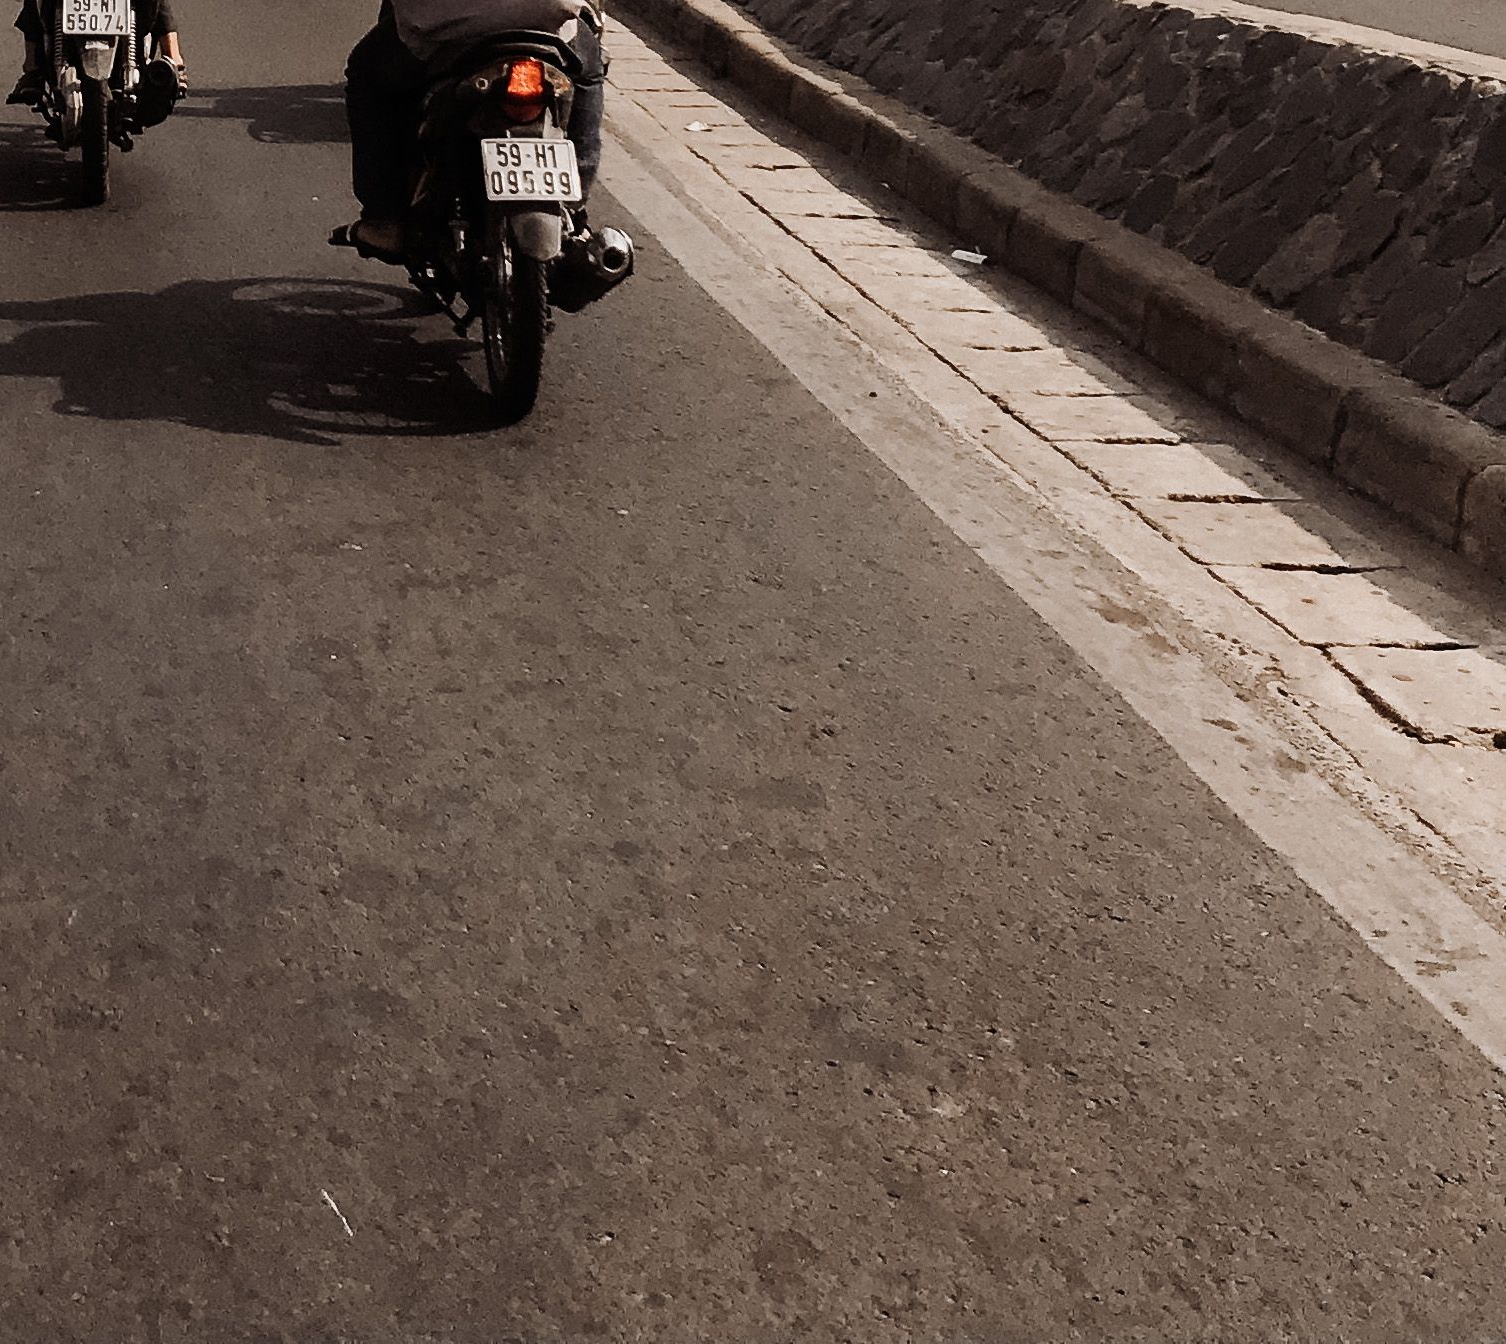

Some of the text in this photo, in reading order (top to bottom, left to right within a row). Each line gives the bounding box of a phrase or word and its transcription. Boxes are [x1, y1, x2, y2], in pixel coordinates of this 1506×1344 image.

[67, 14, 124, 32] 550.74
[496, 143, 558, 168] 59-H1
[491, 170, 571, 195] 095.99
